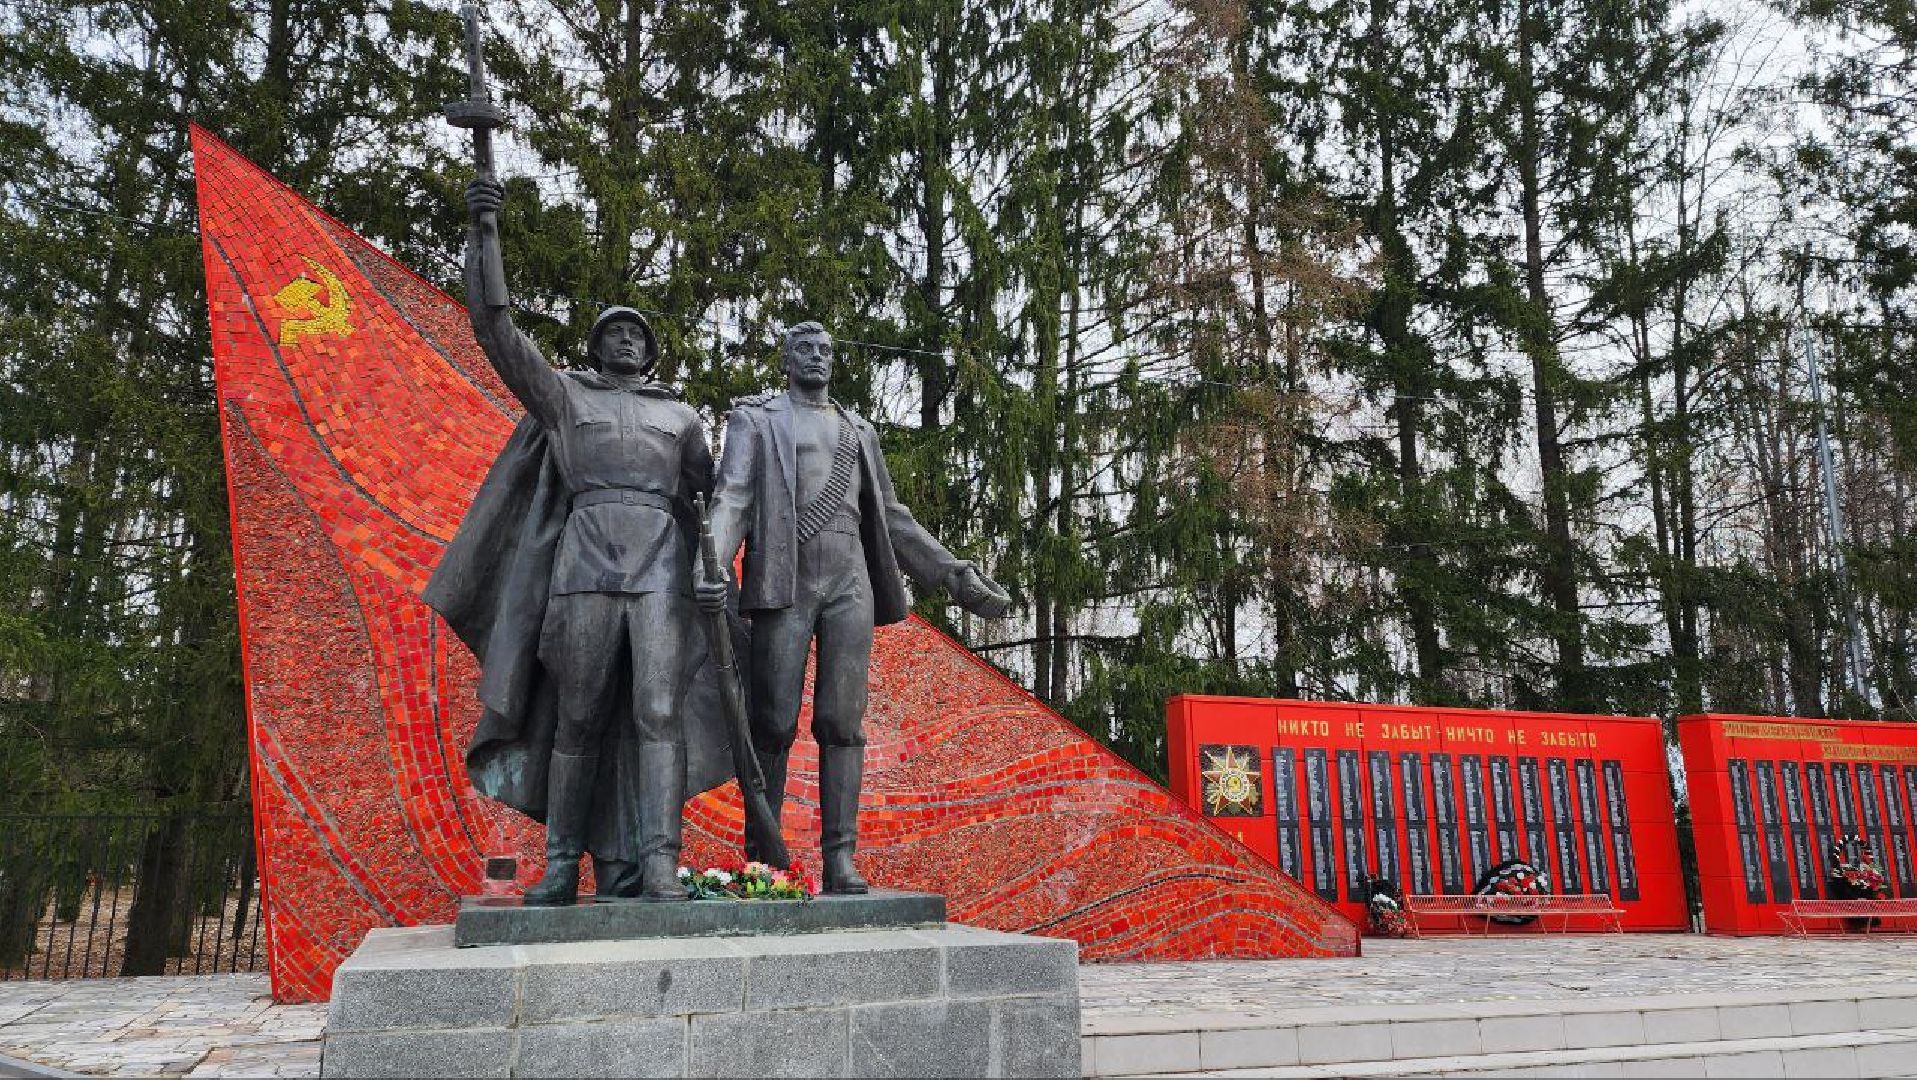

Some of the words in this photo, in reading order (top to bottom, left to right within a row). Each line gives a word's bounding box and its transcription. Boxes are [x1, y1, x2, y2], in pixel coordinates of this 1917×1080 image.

[1278, 719, 1329, 737] НИКТО
[1345, 722, 1365, 739] НЕ
[1381, 723, 1431, 740] ЗАБЫТ
[1445, 726, 1494, 743] НИЧТО
[1507, 729, 1526, 745] НЕ
[1541, 731, 1597, 748] ЗАБЫТО
